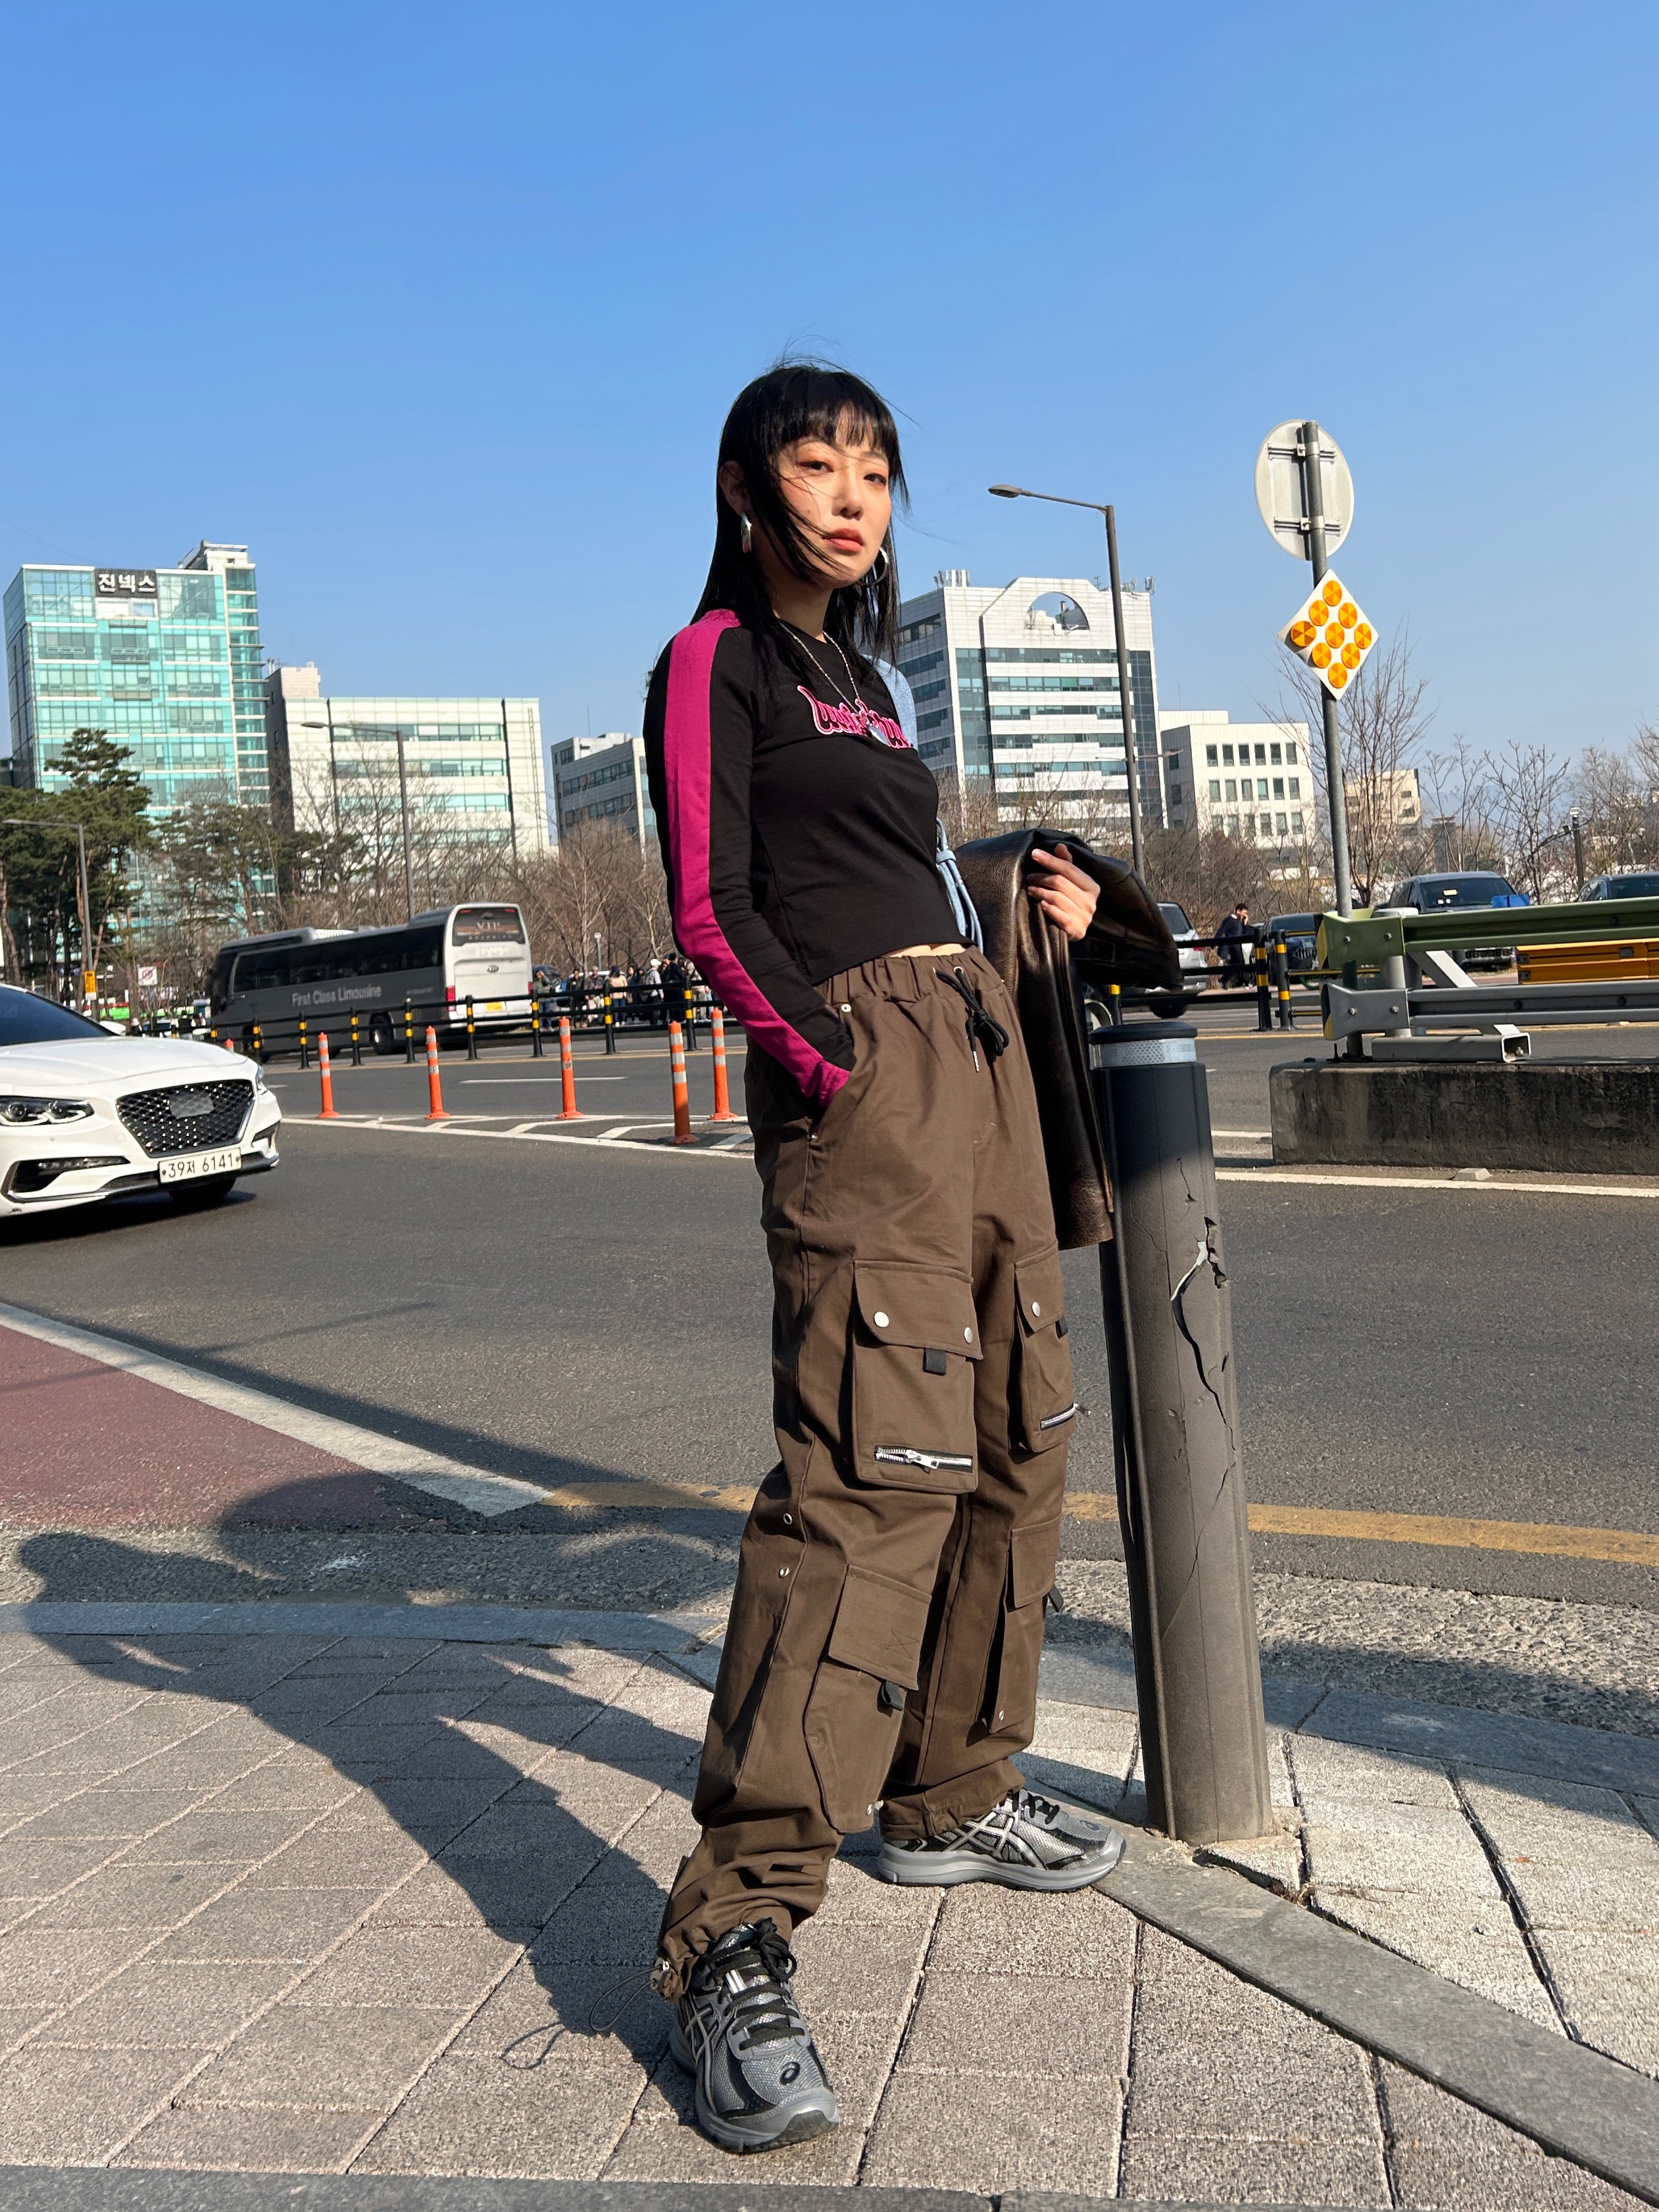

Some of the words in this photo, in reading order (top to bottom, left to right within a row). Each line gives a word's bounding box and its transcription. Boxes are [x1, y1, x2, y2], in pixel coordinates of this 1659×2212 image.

[98, 574, 156, 593] 진넥스
[291, 992, 310, 1006] First
[313, 989, 336, 1004] Class
[338, 985, 382, 1001] Limousine
[168, 1160, 195, 1178] 39저
[202, 1153, 233, 1172] 6141
